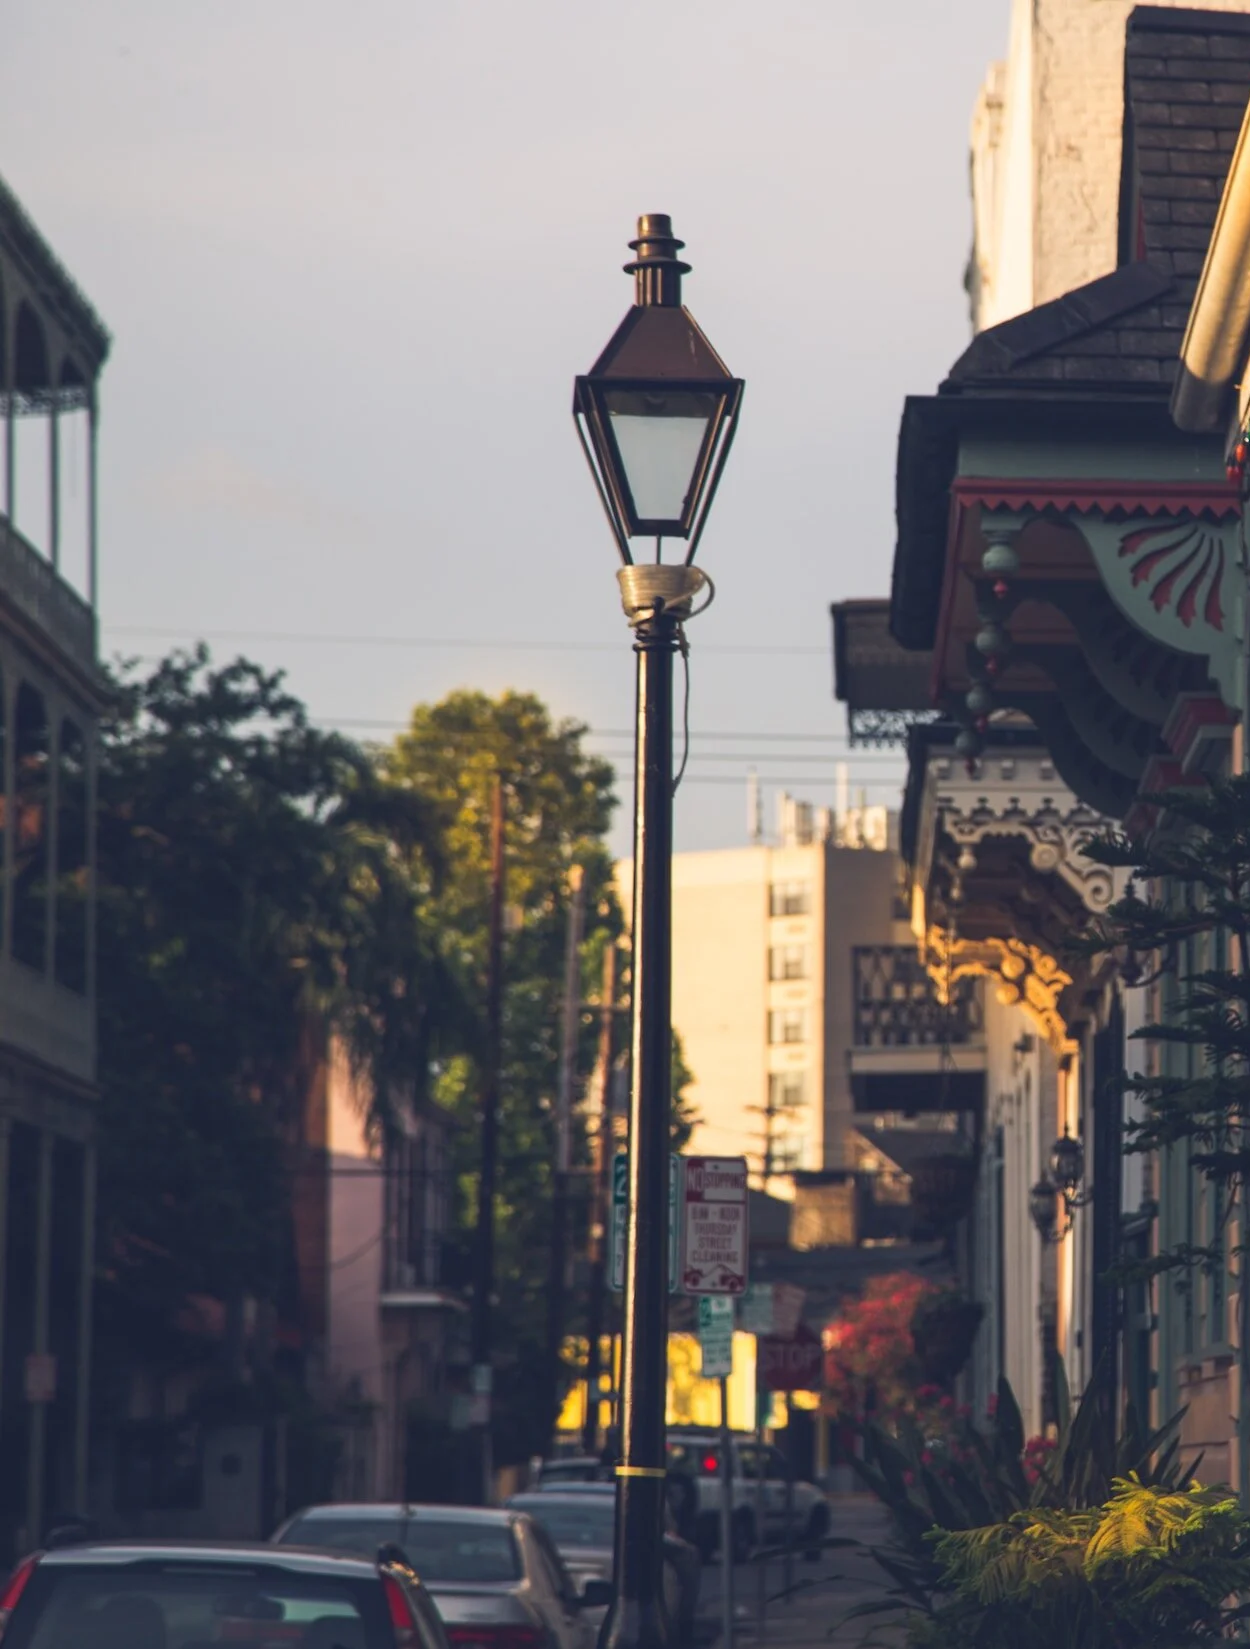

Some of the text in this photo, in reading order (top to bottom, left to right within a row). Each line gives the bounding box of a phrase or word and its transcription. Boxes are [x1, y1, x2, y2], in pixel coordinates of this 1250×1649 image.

[688, 1167, 703, 1191] NO
[703, 1172, 745, 1189] STOPPING
[694, 1222, 737, 1235] THURSDAY
[698, 1236, 732, 1249] STREET
[691, 1250, 738, 1263] CLEANING
[765, 1343, 818, 1368] STOP
